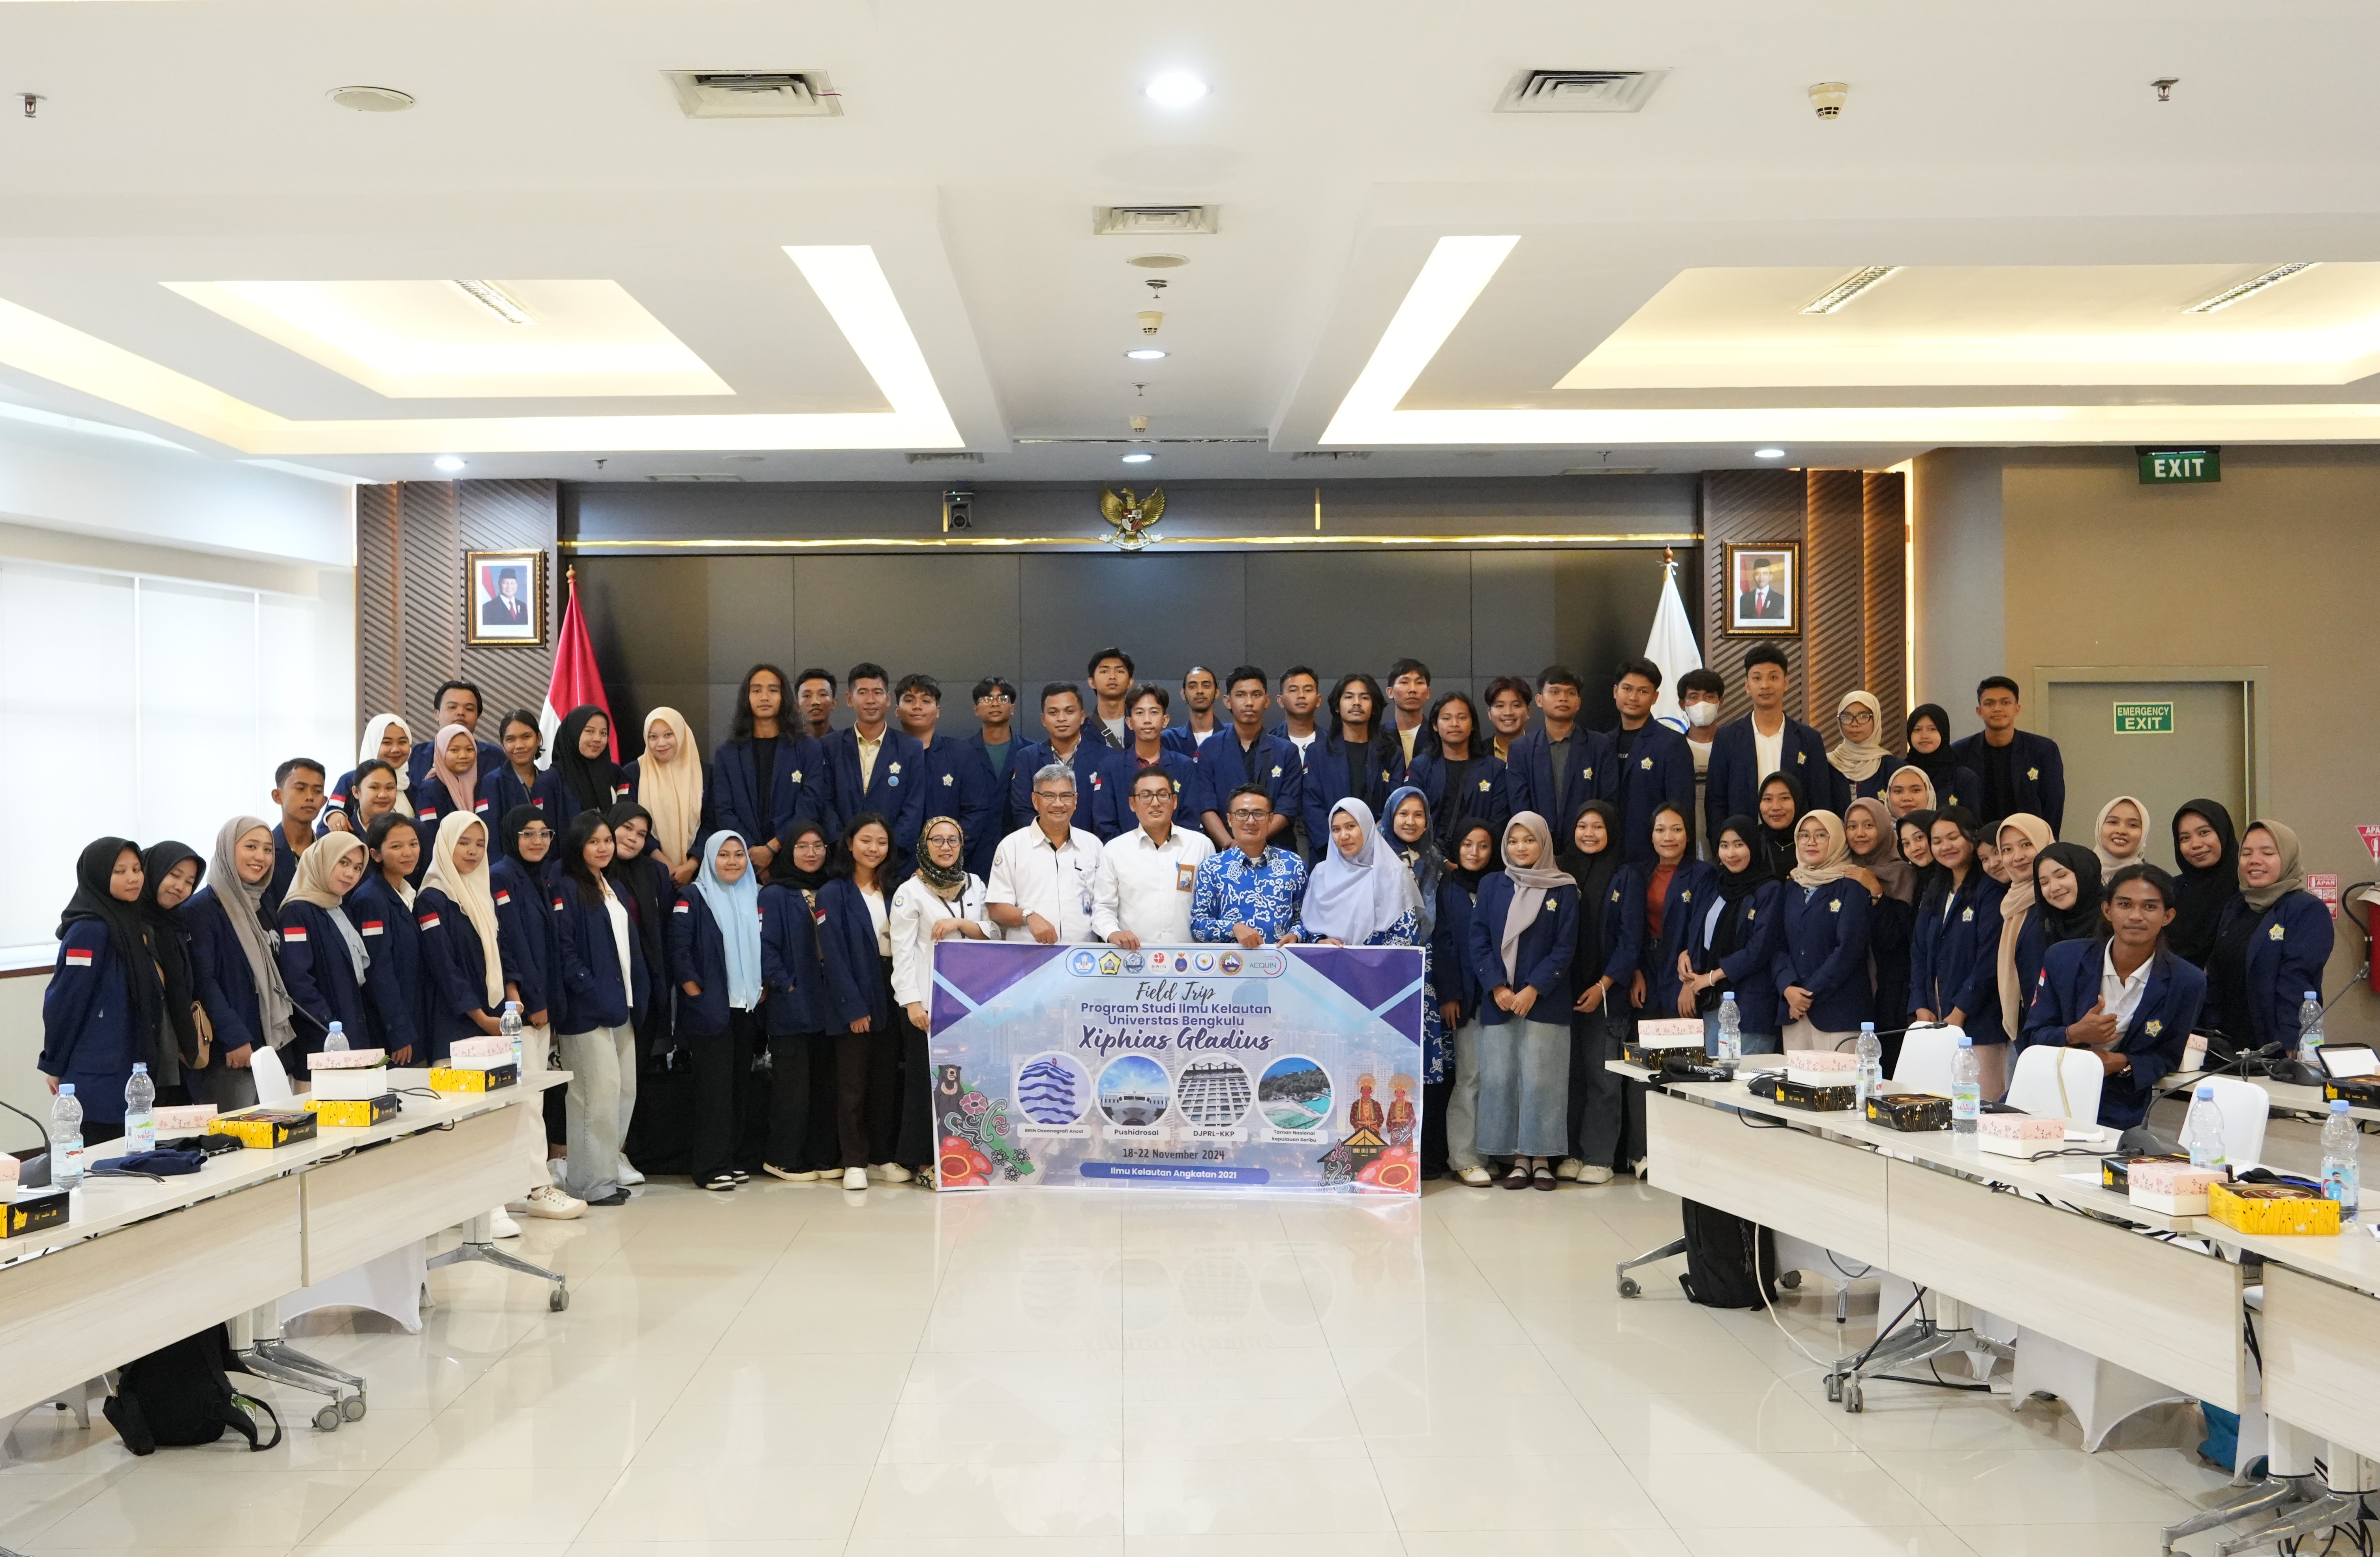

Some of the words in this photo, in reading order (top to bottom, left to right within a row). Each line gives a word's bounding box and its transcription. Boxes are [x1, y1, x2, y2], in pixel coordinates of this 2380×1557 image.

[2154, 459, 2204, 478] EXIT
[2117, 707, 2170, 716] EMERGENCY
[2125, 717, 2162, 730] EXIT
[1136, 979, 1178, 1002] Field
[1182, 981, 1216, 1005] Trip
[1081, 1003, 1138, 1015] Program
[1142, 1003, 1176, 1013] Studi
[1179, 1003, 1208, 1013] Ilmu
[1212, 1004, 1272, 1014] Kelautan
[1108, 1015, 1178, 1025] Universtas
[1182, 1016, 1244, 1029] Bengkulu
[1078, 1024, 1172, 1057] Xiphias
[1176, 1026, 1275, 1051] Gladius
[1123, 1148, 1149, 1158] 18-22
[1152, 1149, 1198, 1159] November
[1202, 1150, 1225, 1160] 2024
[1132, 1168, 1172, 1176] Kelautan
[1173, 1170, 1217, 1180] Angkatan
[1218, 1171, 1237, 1179] 2021
